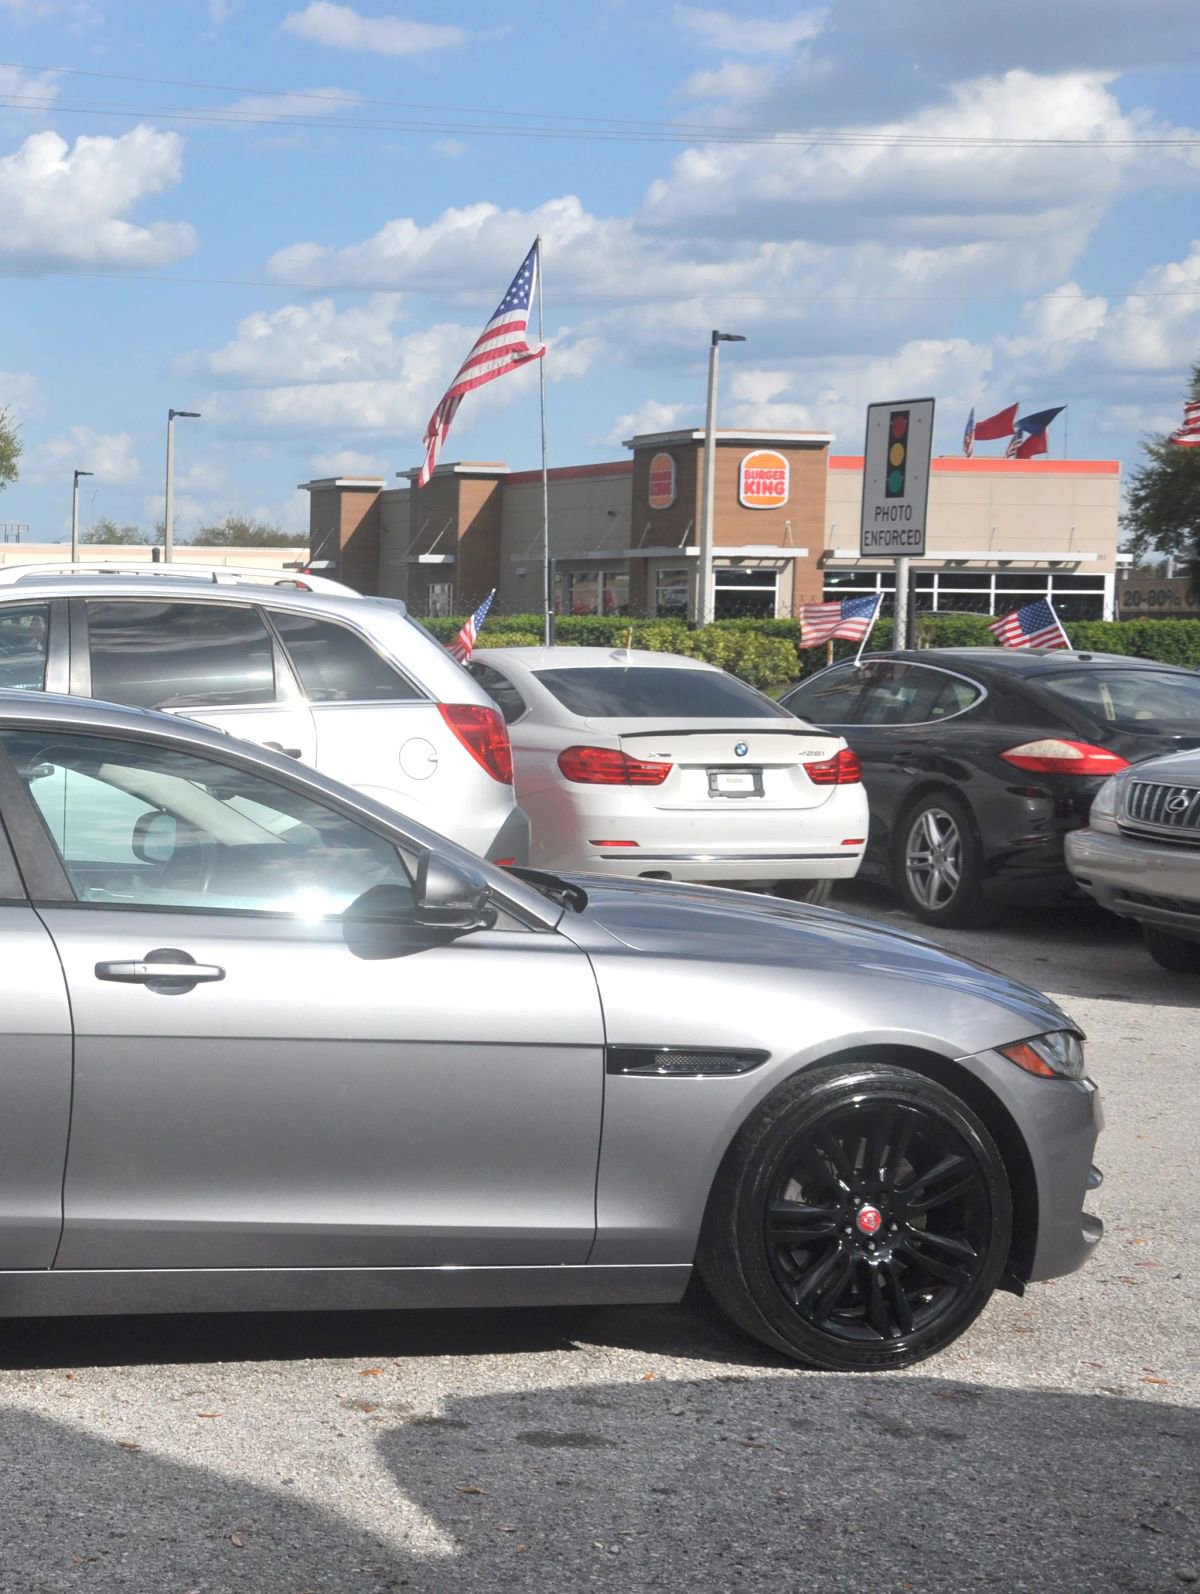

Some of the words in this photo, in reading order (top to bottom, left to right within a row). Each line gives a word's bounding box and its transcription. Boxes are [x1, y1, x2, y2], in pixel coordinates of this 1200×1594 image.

[744, 470, 786, 480] BURGER
[744, 480, 786, 495] KING
[874, 504, 913, 522] PHOTO
[864, 529, 922, 547] ENFORCED
[1123, 588, 1182, 607] 20-80%
